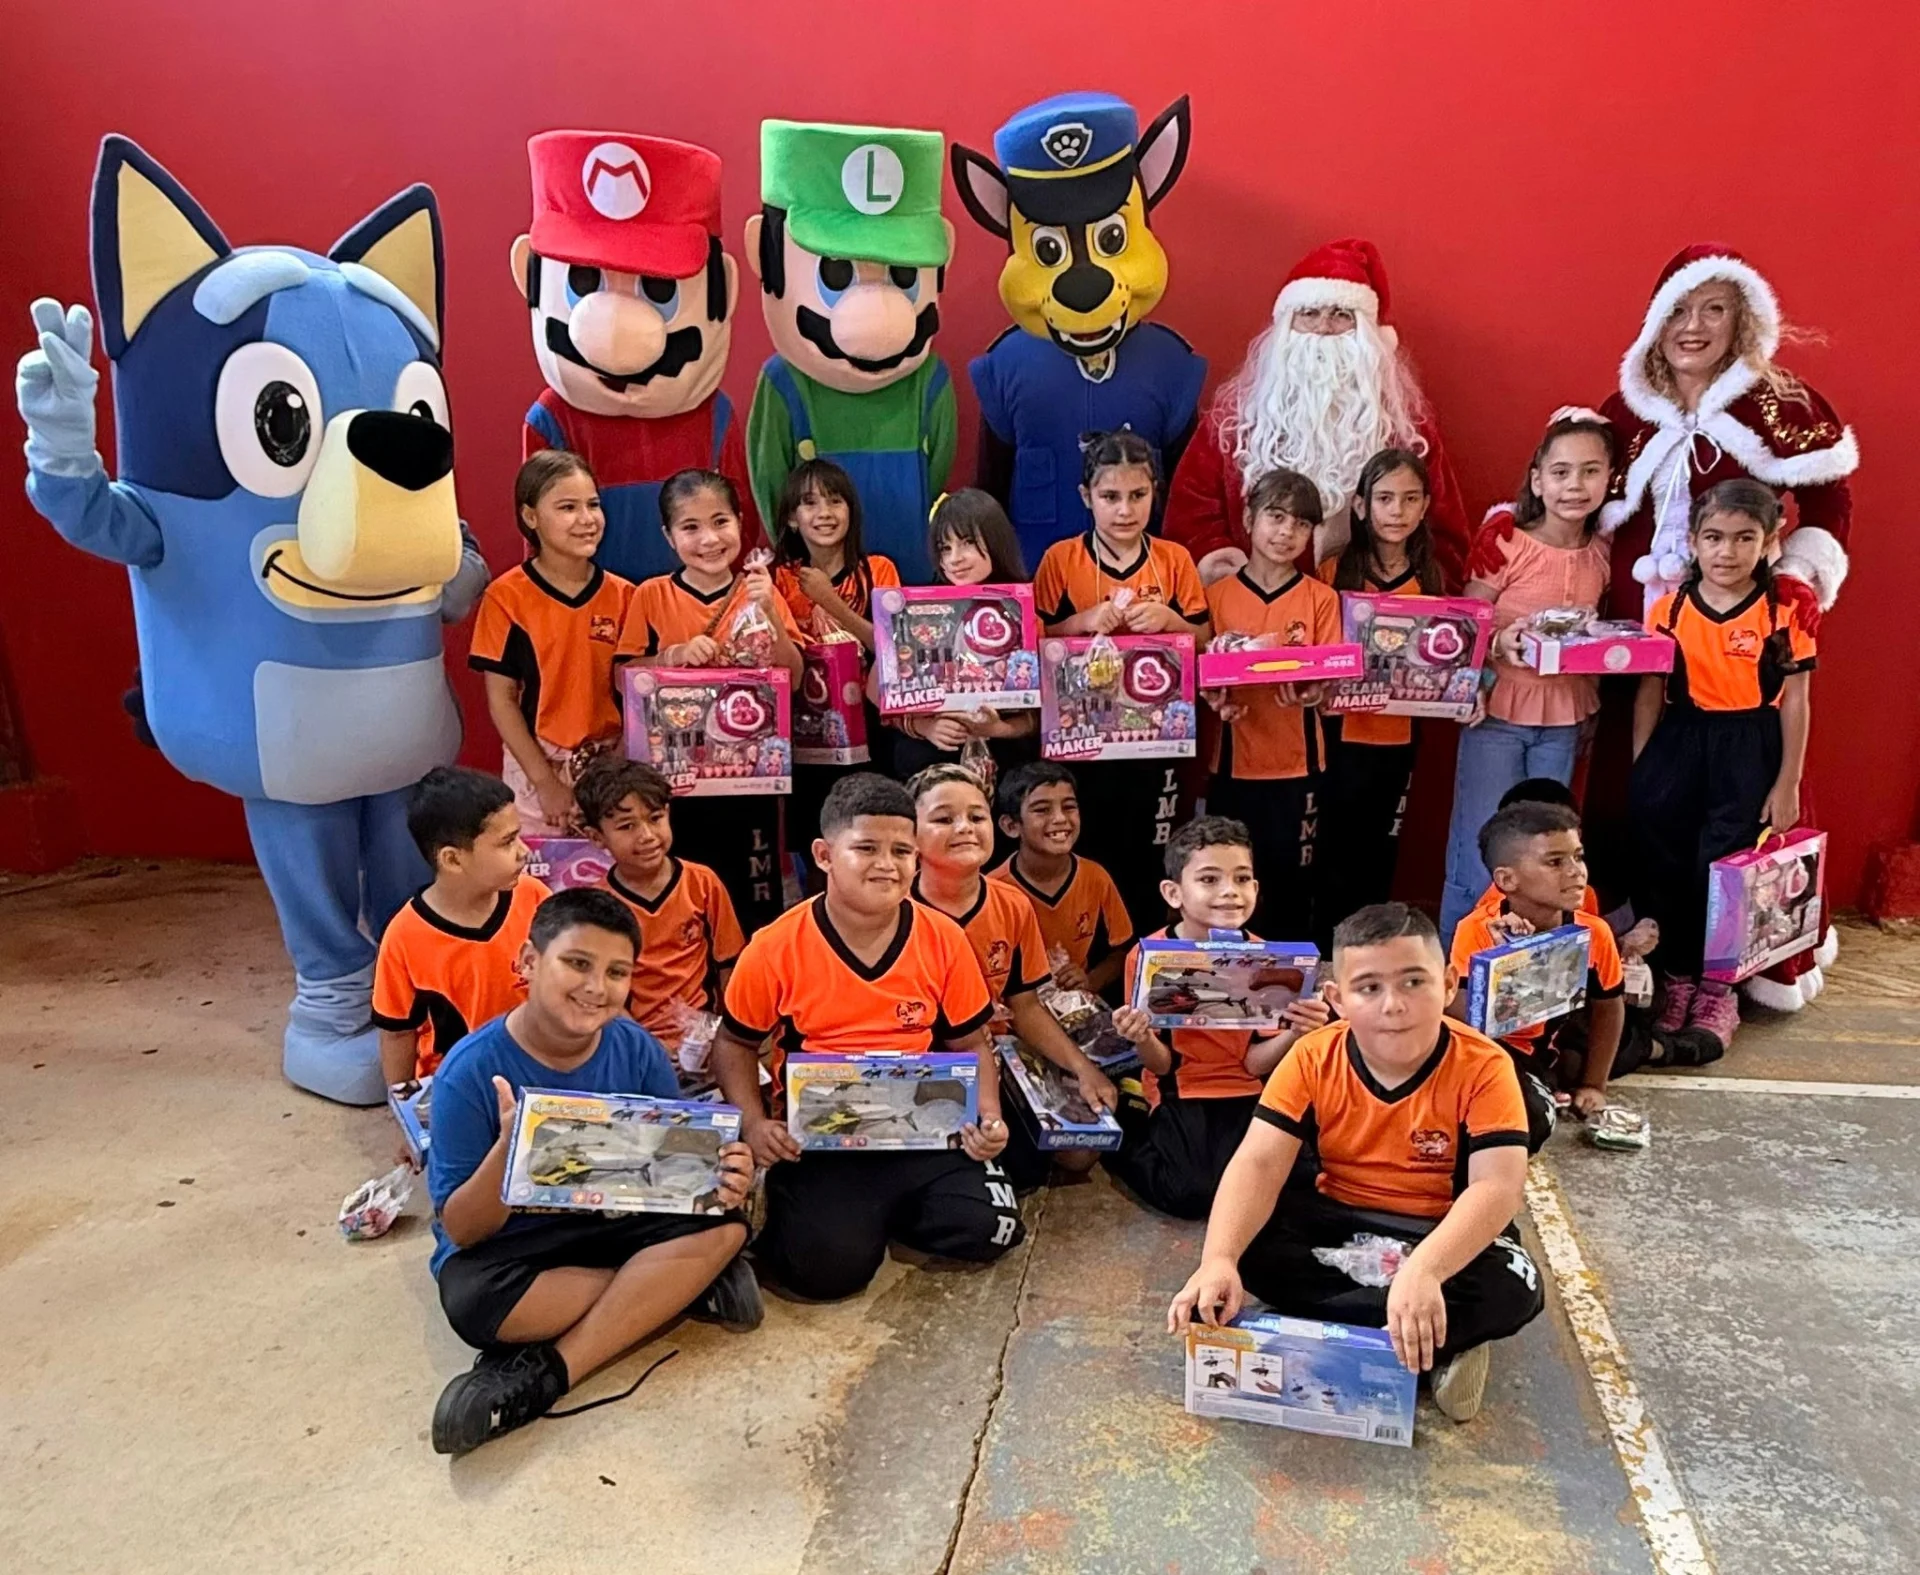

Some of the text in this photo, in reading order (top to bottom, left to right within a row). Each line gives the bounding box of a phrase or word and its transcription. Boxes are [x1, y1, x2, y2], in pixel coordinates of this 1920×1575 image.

[586, 157, 649, 201] M
[866, 150, 892, 202] L
[888, 674, 937, 695] GLAM
[1339, 682, 1384, 695] GLAM
[885, 687, 946, 710] MAKER
[1332, 694, 1390, 708] MAKER
[1048, 724, 1096, 743] GLAM
[1044, 736, 1103, 758] MAKER
